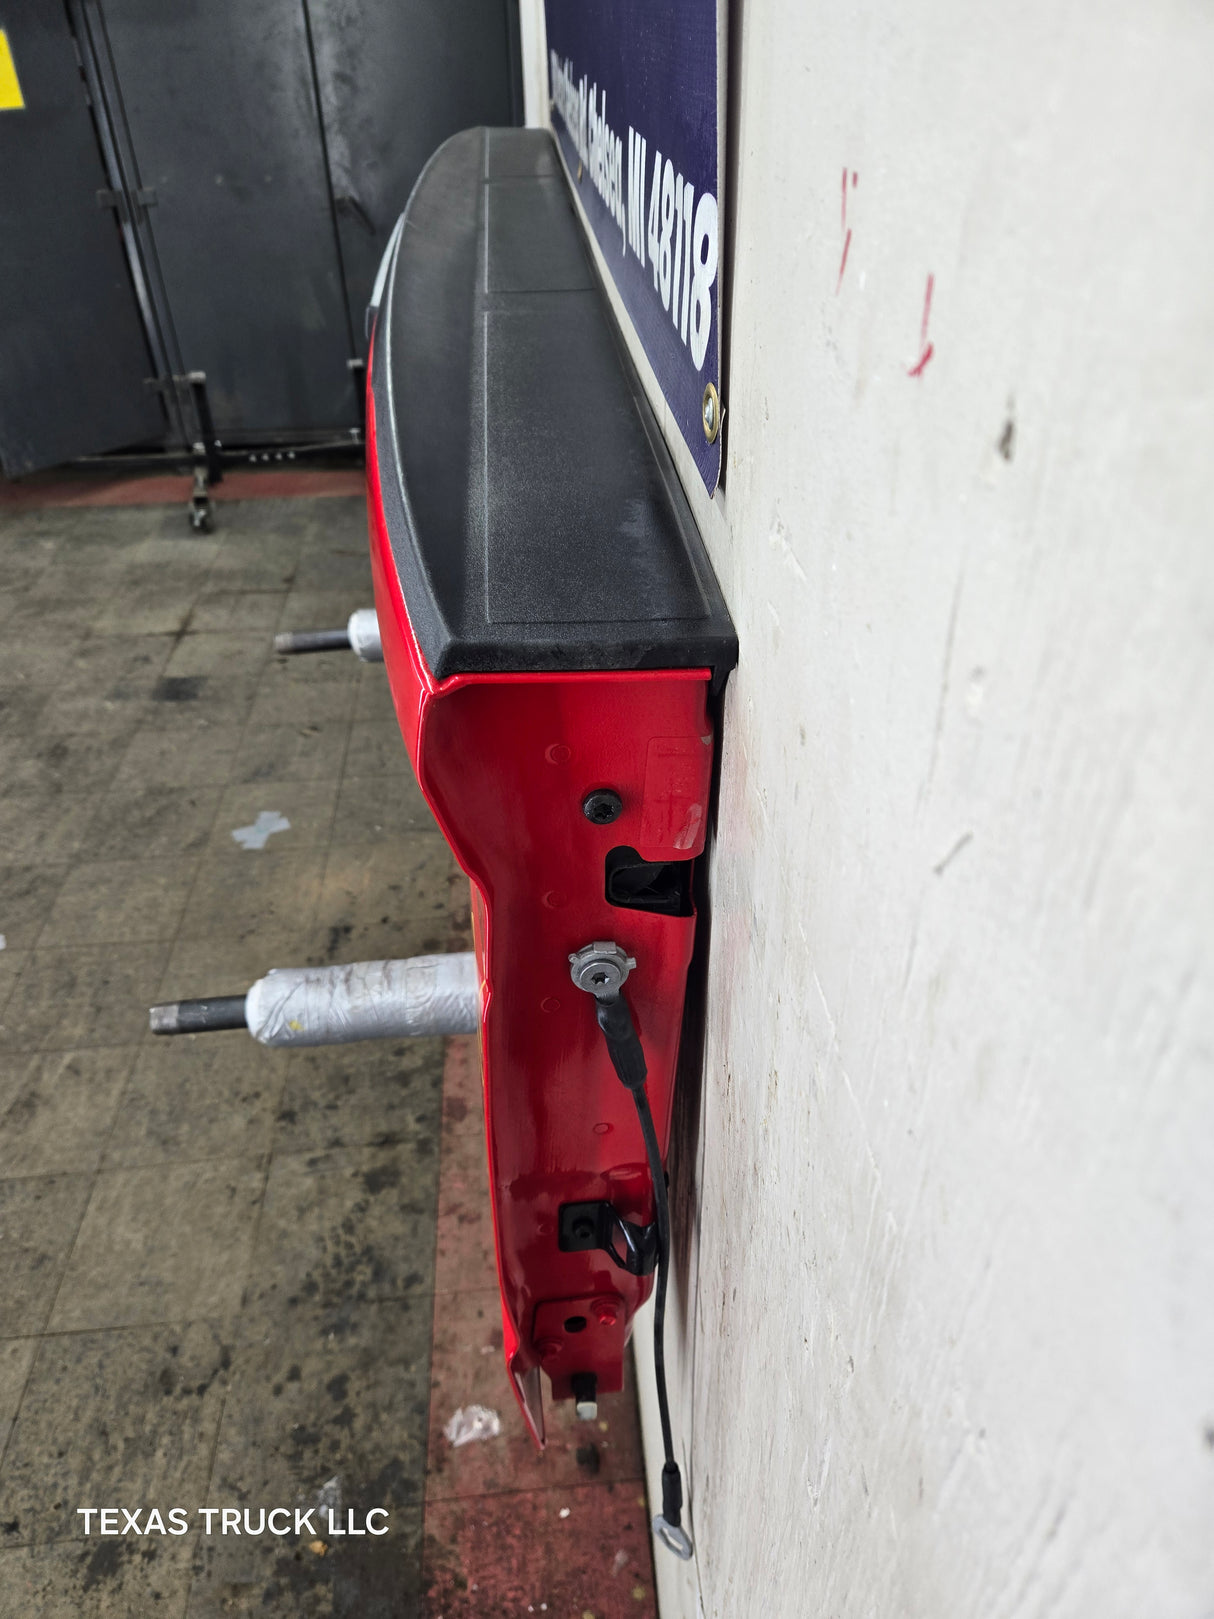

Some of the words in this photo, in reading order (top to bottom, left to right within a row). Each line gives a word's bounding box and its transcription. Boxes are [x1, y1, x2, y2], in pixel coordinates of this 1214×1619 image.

[588, 82, 626, 257] Chelsea,
[628, 125, 647, 269] MI
[648, 150, 718, 371] 48118
